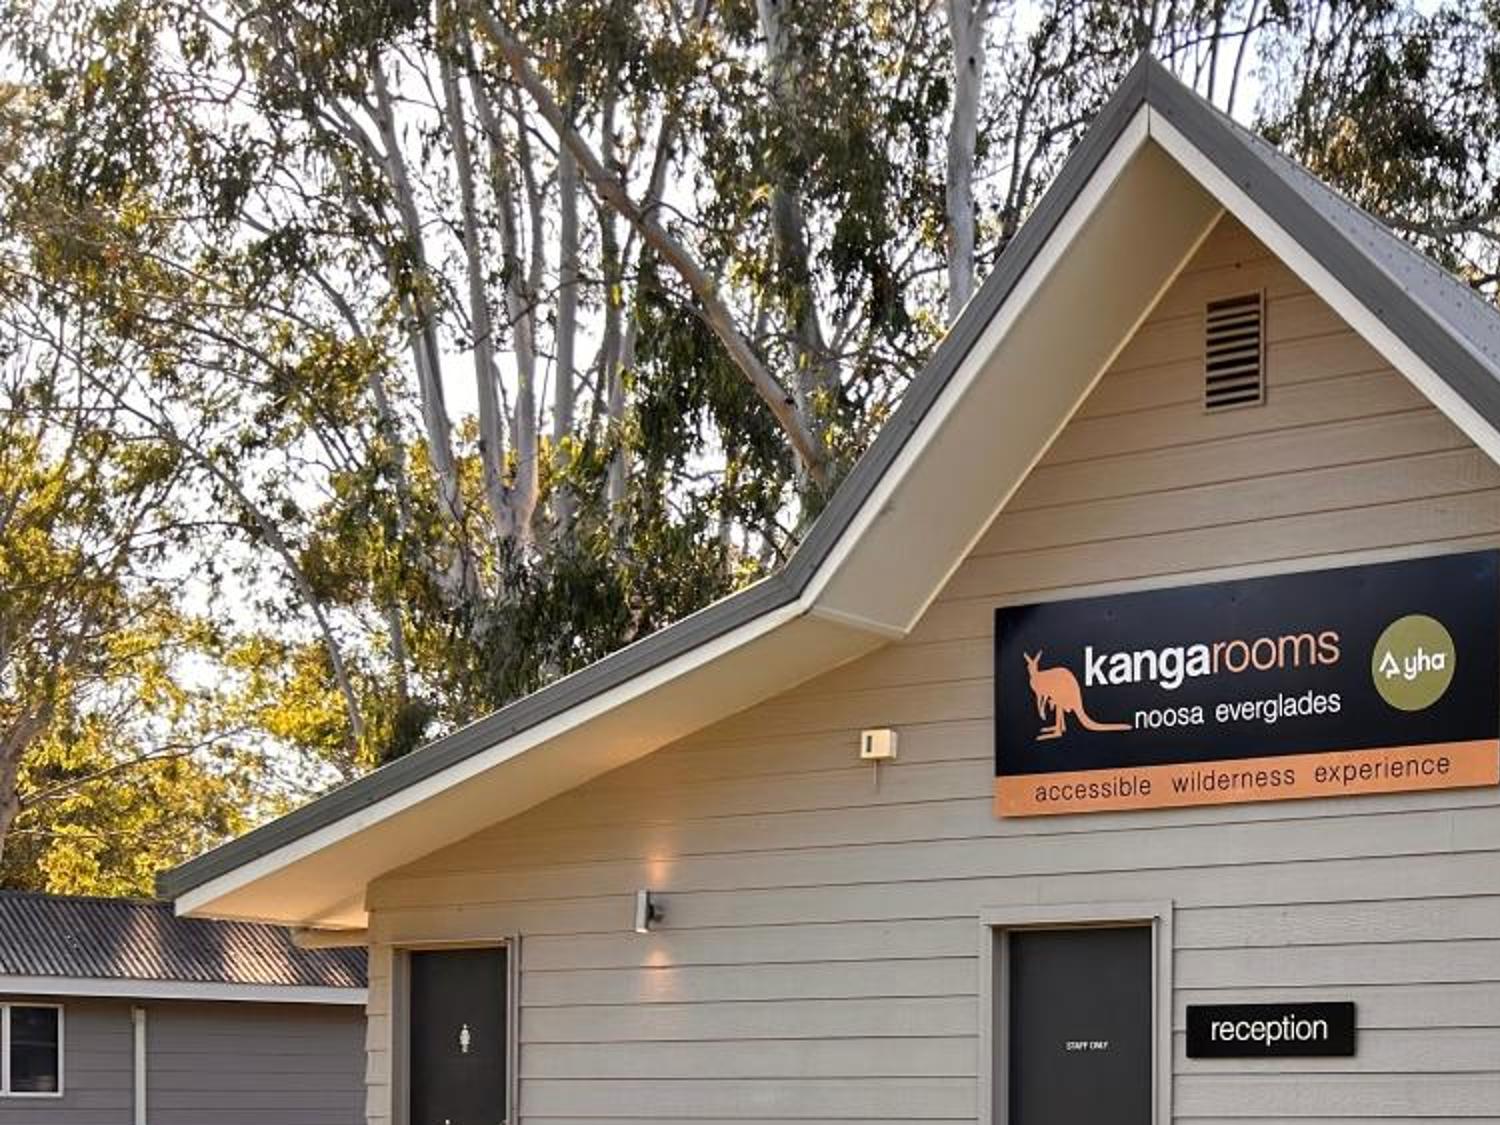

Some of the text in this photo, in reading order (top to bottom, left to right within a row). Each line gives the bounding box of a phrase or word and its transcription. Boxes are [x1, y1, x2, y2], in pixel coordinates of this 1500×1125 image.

[1084, 630, 1340, 689] kangarooms
[1403, 646, 1446, 680] yha
[1134, 691, 1341, 729] noosa everglades
[1034, 756, 1450, 802] accessible wilderness experience
[1065, 1041, 1108, 1050] STAFF ONLY
[1211, 1014, 1328, 1046] reception
